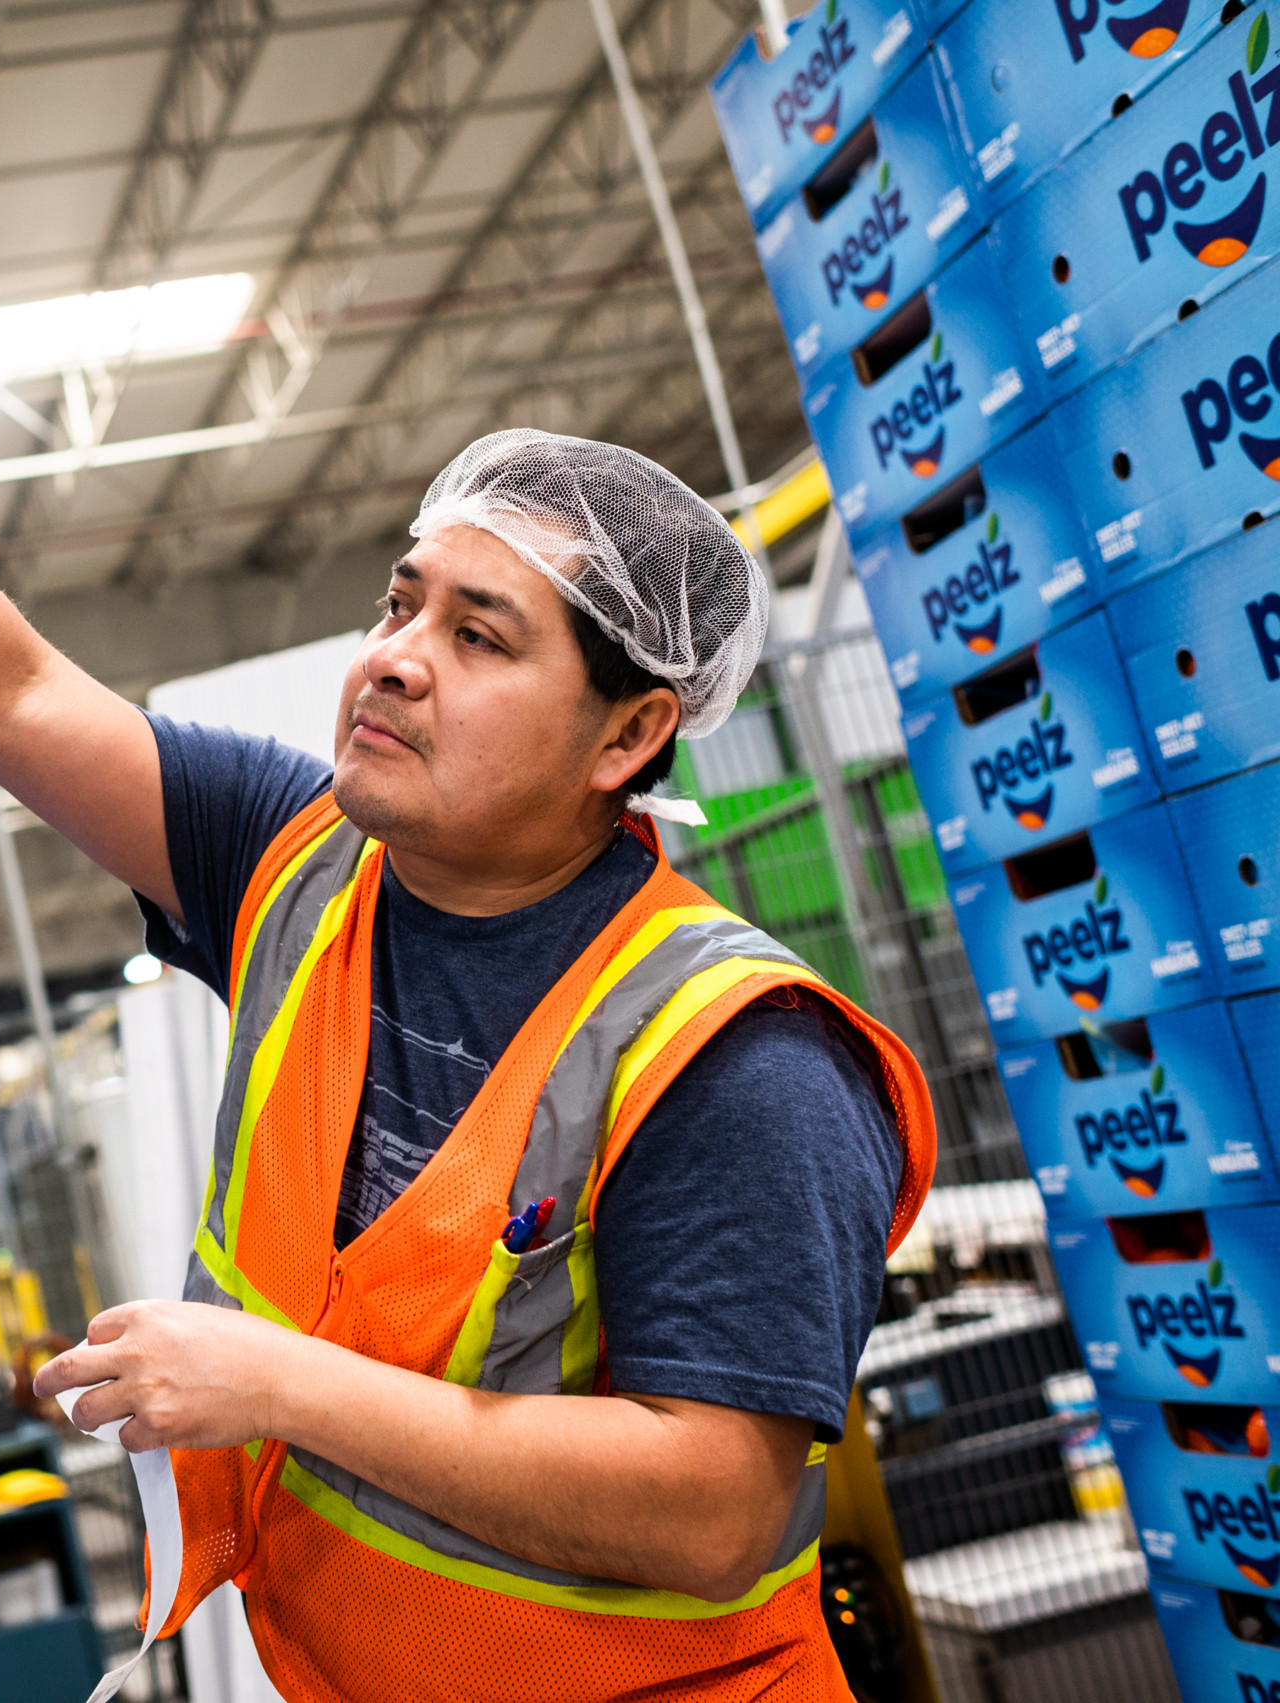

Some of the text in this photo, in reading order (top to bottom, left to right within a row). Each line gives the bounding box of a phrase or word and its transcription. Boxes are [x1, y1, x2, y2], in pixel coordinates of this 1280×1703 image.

[772, 16, 857, 145] peelz
[821, 186, 911, 306] peelz
[869, 358, 963, 472] peelz
[922, 541, 1022, 642] peelz
[970, 720, 1074, 811] peelz
[1023, 902, 1131, 987] peelz
[1074, 1091, 1189, 1168] peelz
[1126, 1279, 1246, 1349] peelz
